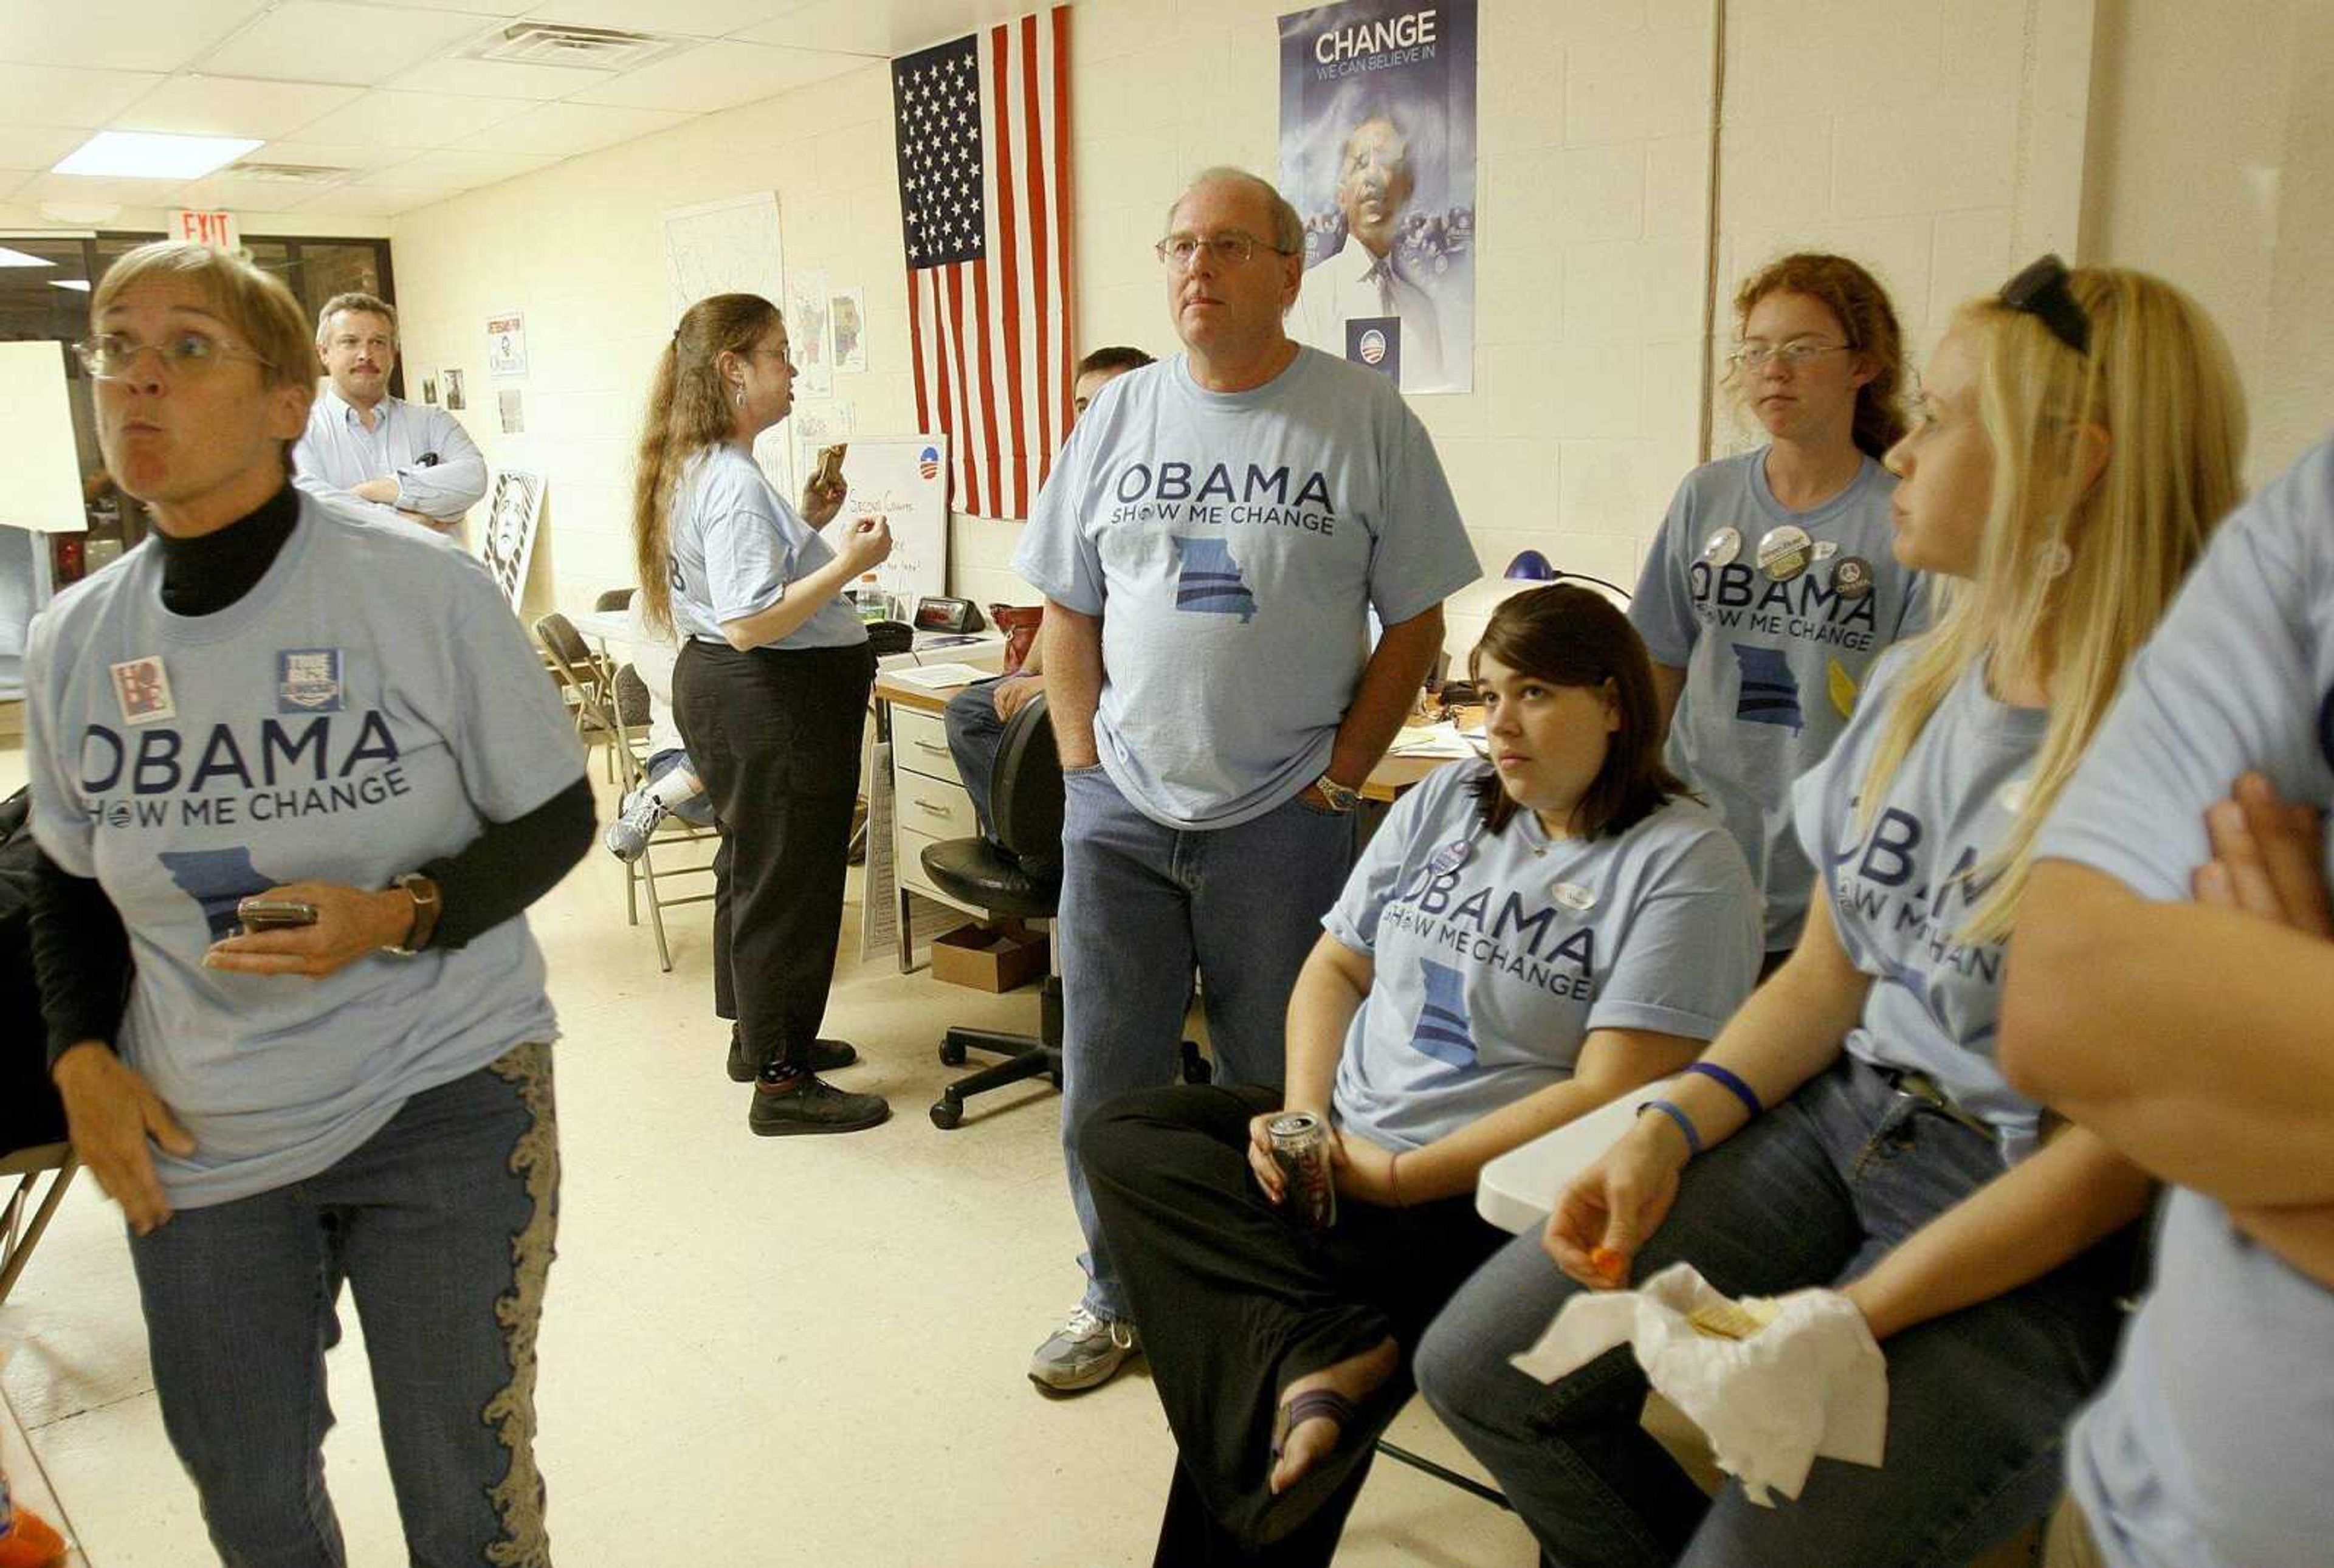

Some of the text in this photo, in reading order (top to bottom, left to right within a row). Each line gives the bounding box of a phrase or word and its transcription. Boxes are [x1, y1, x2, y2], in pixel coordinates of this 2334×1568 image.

[1315, 10, 1436, 64] CHANGE
[1316, 45, 1436, 81] WE CAN BELIEVE IN
[183, 212, 229, 246] EXIT
[1117, 462, 1335, 515] OBAMA
[1110, 503, 1337, 537] SHOW ME CHANGE
[1691, 561, 1876, 632] OBAMA
[1750, 613, 1781, 634] ME
[1788, 619, 1876, 652] CHANGE
[80, 709, 399, 795] OBAMA
[182, 798, 235, 825] ME
[249, 767, 411, 822] CHANGE
[1439, 926, 1472, 954] ME
[1473, 939, 1591, 1002] CHANGE
